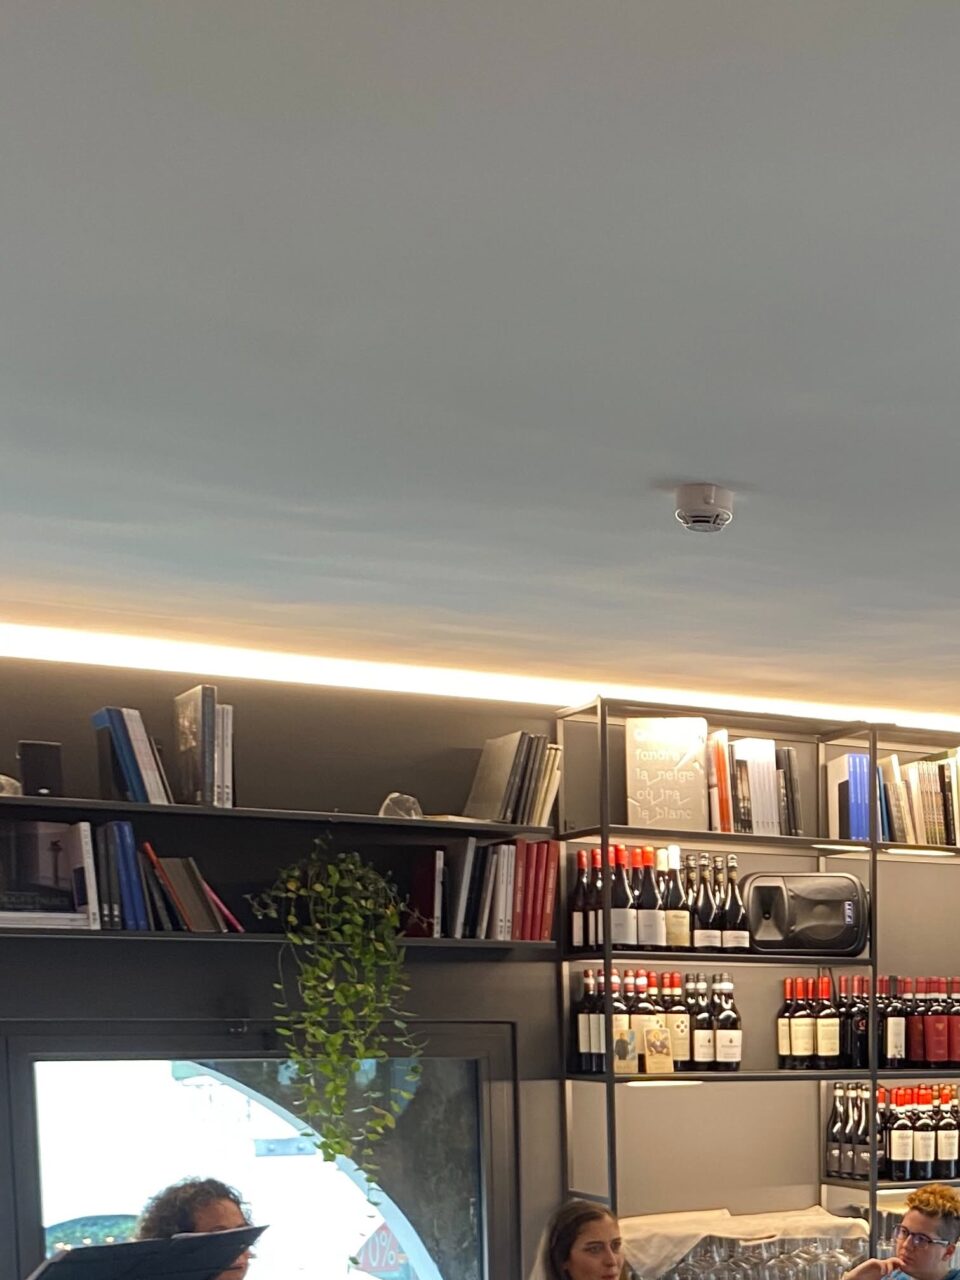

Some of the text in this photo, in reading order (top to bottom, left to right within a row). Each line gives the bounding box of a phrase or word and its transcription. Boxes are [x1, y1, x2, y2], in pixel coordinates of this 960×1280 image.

[636, 768, 695, 782] la neige
[637, 806, 691, 819] le blanc
